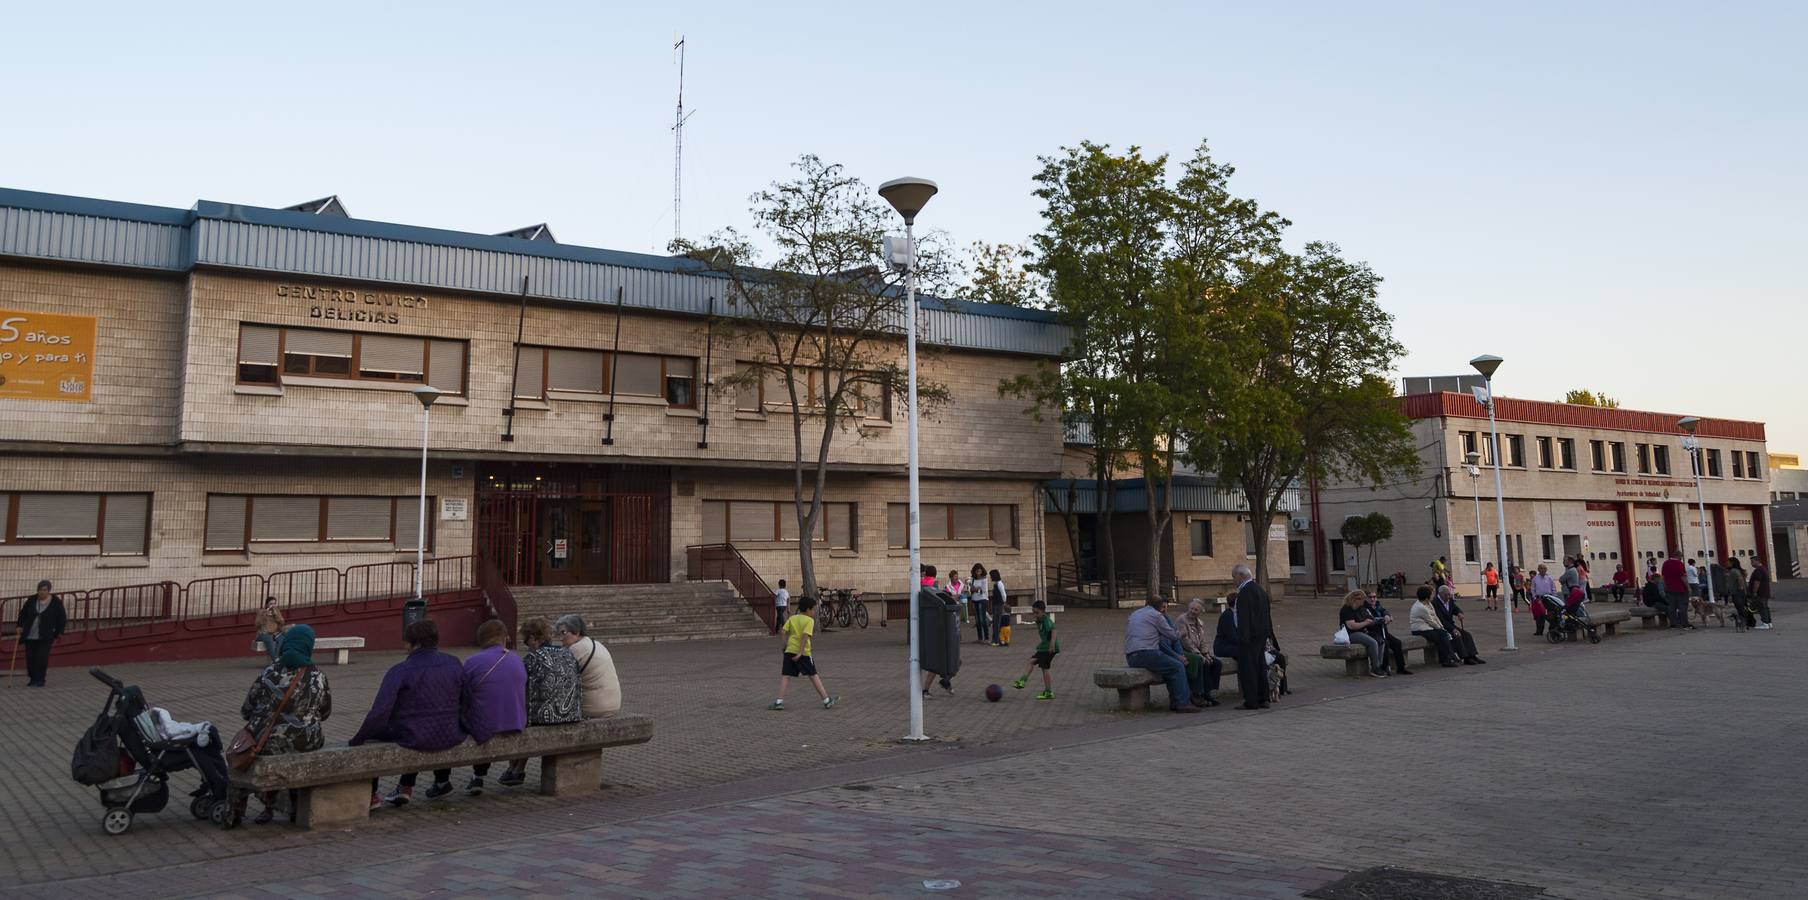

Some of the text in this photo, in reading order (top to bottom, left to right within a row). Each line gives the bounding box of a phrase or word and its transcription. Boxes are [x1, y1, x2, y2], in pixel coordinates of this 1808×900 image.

[276, 285, 357, 303] CENTRO
[310, 305, 399, 325] DELICIAS
[25, 330, 71, 344] años
[17, 354, 29, 364] y
[35, 353, 69, 362] para
